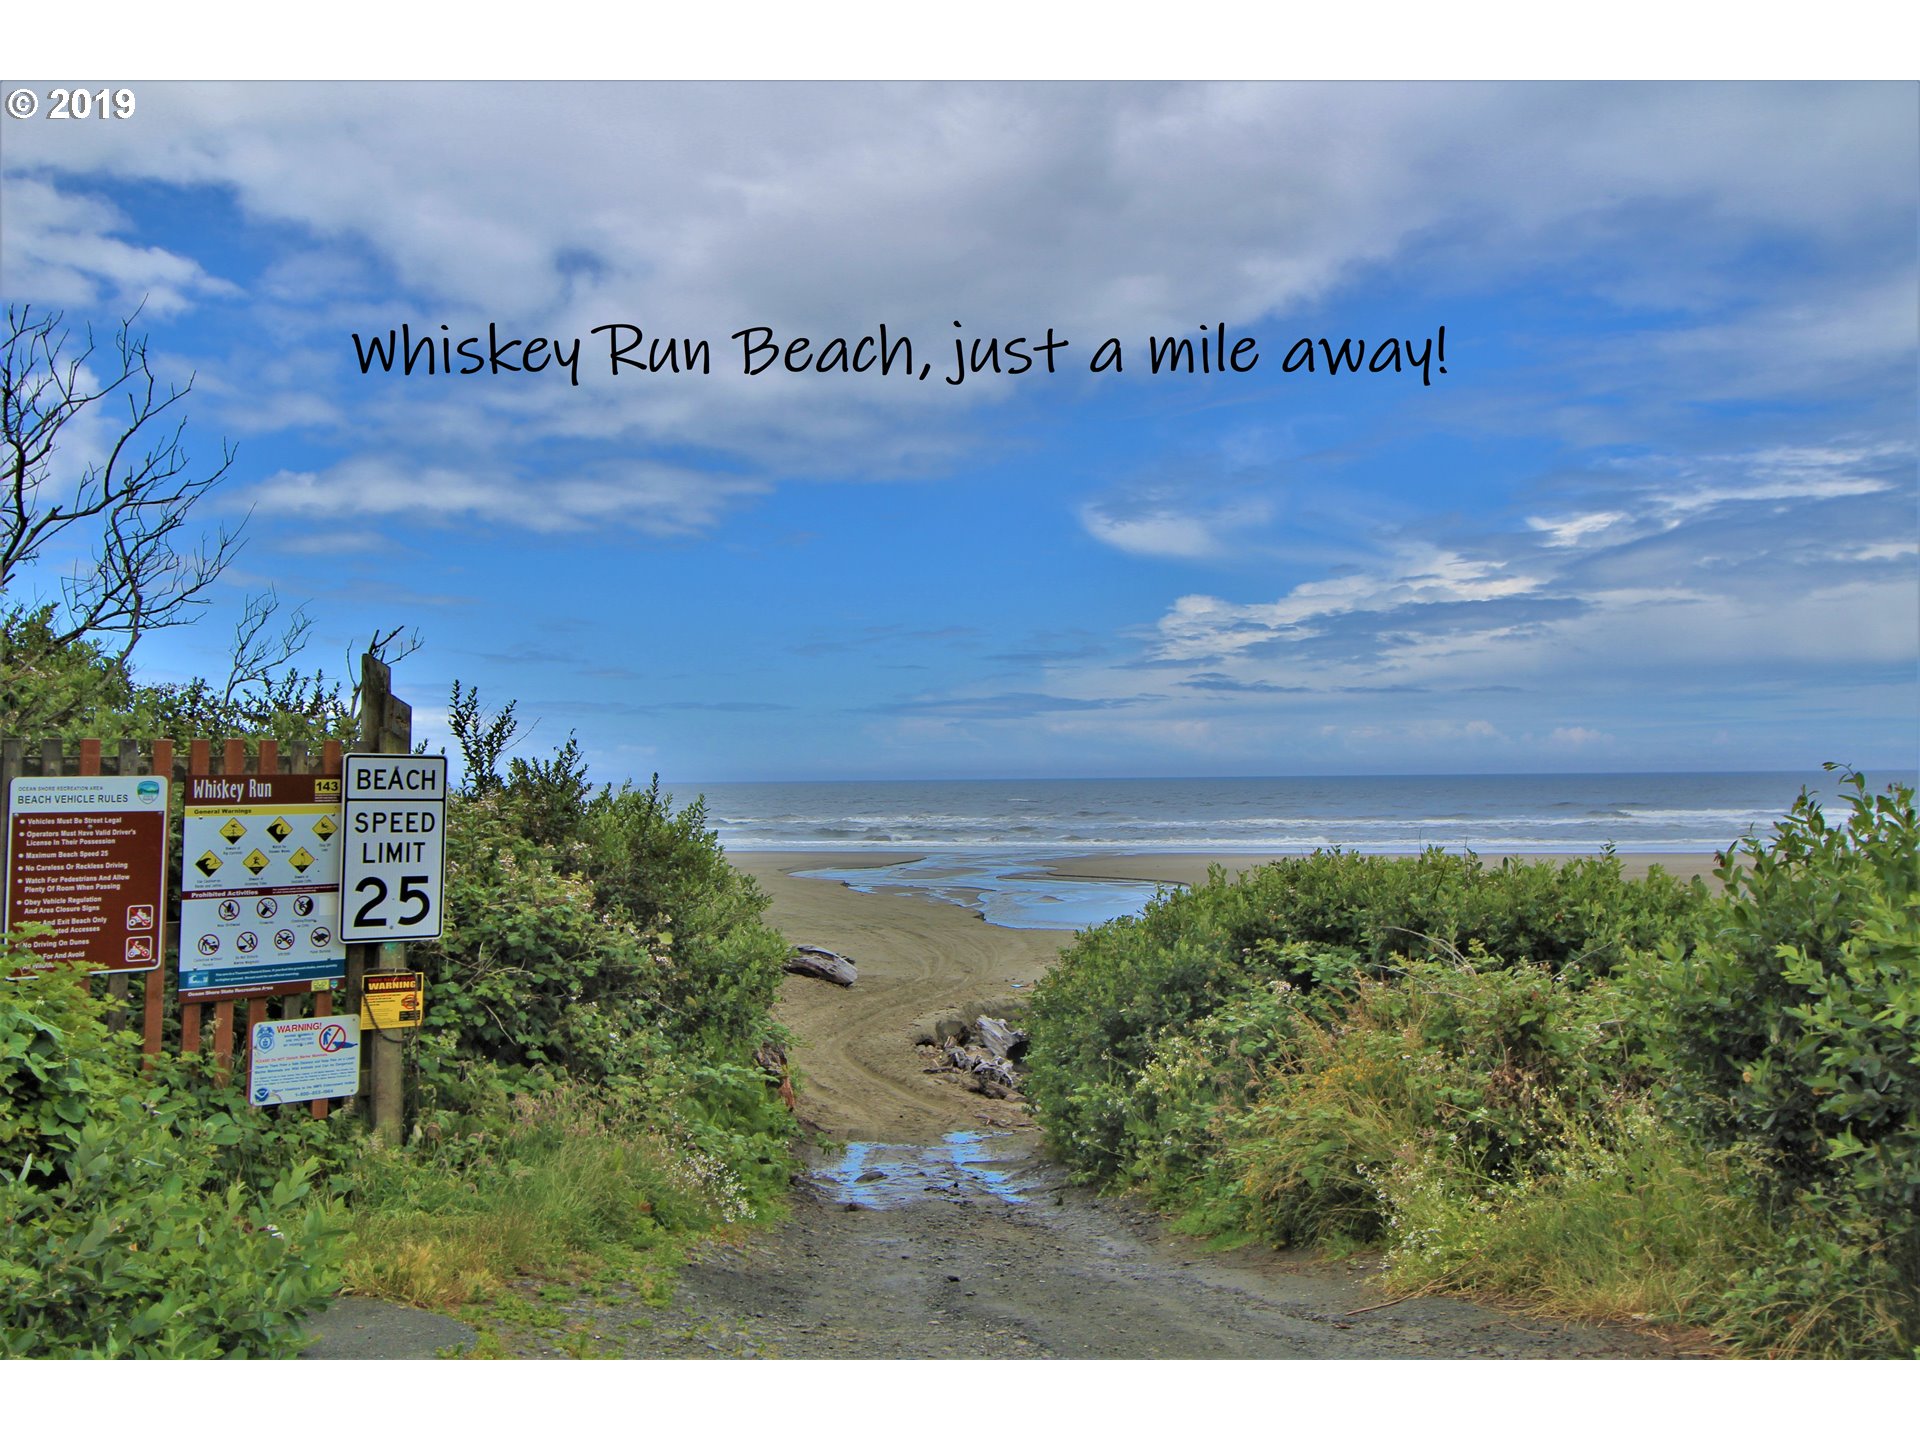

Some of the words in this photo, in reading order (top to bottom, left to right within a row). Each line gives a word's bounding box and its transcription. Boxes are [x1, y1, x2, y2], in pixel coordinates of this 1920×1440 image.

[356, 768, 436, 791] BEACH
[193, 779, 244, 803] Whiskey
[249, 778, 272, 798] Run
[316, 781, 339, 792] 143
[18, 795, 52, 804] BEACH
[54, 794, 95, 804] VEHICLE
[98, 794, 129, 803] RULES
[104, 816, 123, 825] Legal
[354, 812, 436, 834] SPEED
[26, 830, 59, 839] Operators
[26, 839, 52, 847] License
[61, 838, 78, 846] Their
[25, 851, 57, 859] Maximum
[79, 850, 99, 858] Speed
[100, 849, 109, 857] 25
[362, 841, 426, 864] LIMIT
[36, 863, 65, 871] Careless
[75, 862, 104, 870] Reckless
[105, 862, 129, 870] Driving
[25, 877, 46, 885] Watch
[47, 876, 59, 884] For
[60, 875, 97, 883] Pedestrians
[24, 886, 46, 894] Plenty
[47, 885, 55, 893] Of
[56, 884, 75, 892] Room
[95, 883, 121, 891] Passing
[191, 891, 226, 899] Prohibited
[227, 889, 259, 897] Activities
[24, 898, 41, 907] Obey
[42, 897, 67, 905] Vehicle
[68, 896, 102, 904] Regulation
[353, 875, 431, 928] 25
[39, 906, 54, 914] Area
[55, 905, 81, 913] Closure
[81, 905, 100, 913] Signs
[71, 917, 92, 925] Beach
[92, 916, 107, 924] Only
[33, 940, 57, 949] Driving
[42, 952, 53, 960] For
[368, 981, 417, 991] WARNING
[276, 1022, 323, 1034] WARNING!
